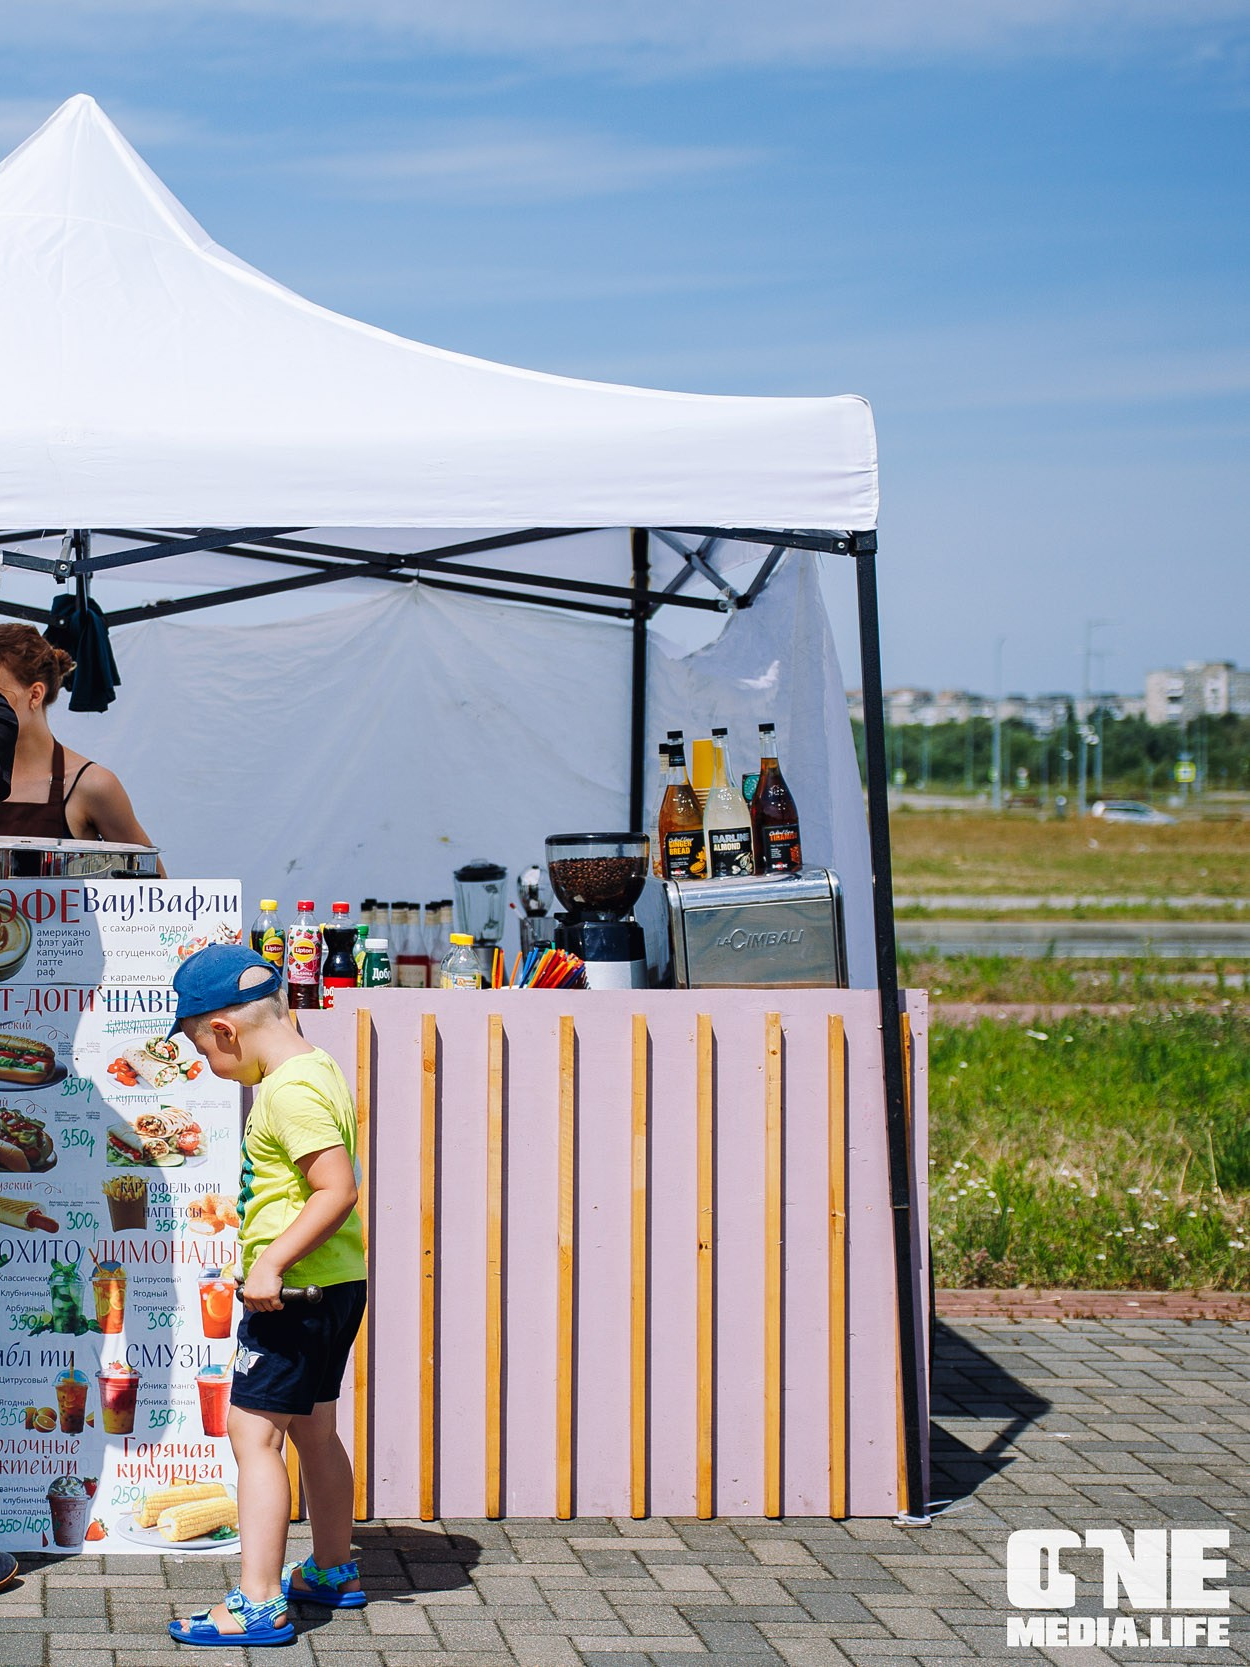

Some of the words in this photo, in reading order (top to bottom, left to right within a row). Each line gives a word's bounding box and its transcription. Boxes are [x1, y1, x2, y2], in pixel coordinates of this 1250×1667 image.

[668, 839, 692, 848] GINGER
[713, 842, 741, 851] ALMOND
[669, 847, 691, 856] BREAD
[110, 924, 156, 934] сахарной
[158, 924, 194, 935] пудрой
[36, 930, 91, 940] американо
[36, 938, 59, 948] флэт
[62, 938, 85, 948] уайт
[36, 949, 84, 958] капучино
[116, 949, 169, 960] сгущенкой
[295, 946, 313, 954] Lipton
[36, 967, 56, 978] раф
[372, 967, 391, 981] Добр
[110, 975, 166, 984] карамелью
[107, 989, 179, 1013] ШАВЕ
[120, 1182, 190, 1194] КАРТОФЕЛЬ
[194, 1182, 221, 1194] ФРИ
[142, 1206, 202, 1218] НАГГЕТСЫ
[92, 1239, 237, 1269] ЛИМОНАДЫ
[132, 1275, 182, 1284] Цитрусовый
[0, 1289, 51, 1298] Клубничный
[132, 1290, 168, 1298] Ягодный
[5, 1304, 46, 1313] Арбузный
[132, 1304, 186, 1313] Тропический
[40, 1350, 75, 1367] ти
[125, 1343, 211, 1368] СМУЗИ
[0, 1376, 49, 1386] Цитрусовый
[138, 1381, 168, 1391] убника
[170, 1398, 196, 1406] банан
[123, 1436, 216, 1464] Горячая
[117, 1463, 223, 1486] кукуруза
[2, 1496, 49, 1506] клубничны
